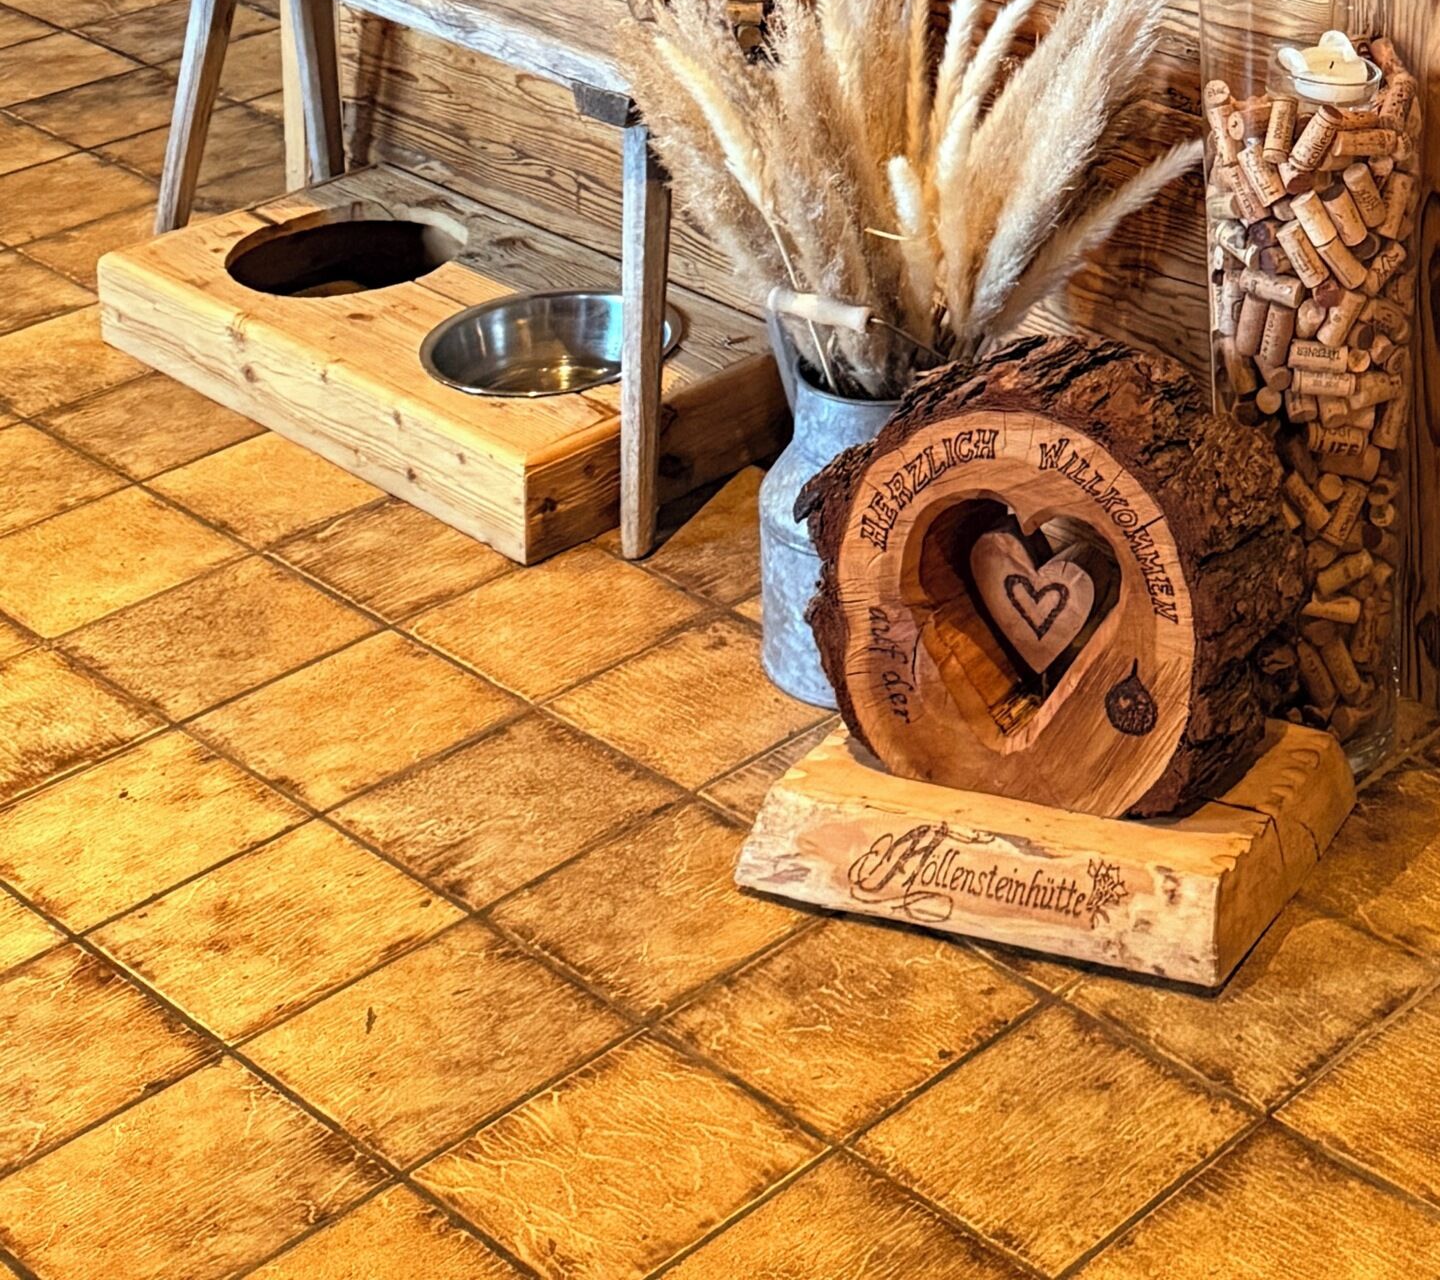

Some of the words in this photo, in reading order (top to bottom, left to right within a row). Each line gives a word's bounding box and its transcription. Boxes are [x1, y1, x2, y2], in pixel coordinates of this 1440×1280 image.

[860, 428, 999, 552] HERZLICH
[1039, 437, 1179, 625] WILLKOMMEN
[868, 607, 908, 664] auf
[882, 671, 914, 724] der
[848, 821, 1086, 922] Höllensteinhütte
